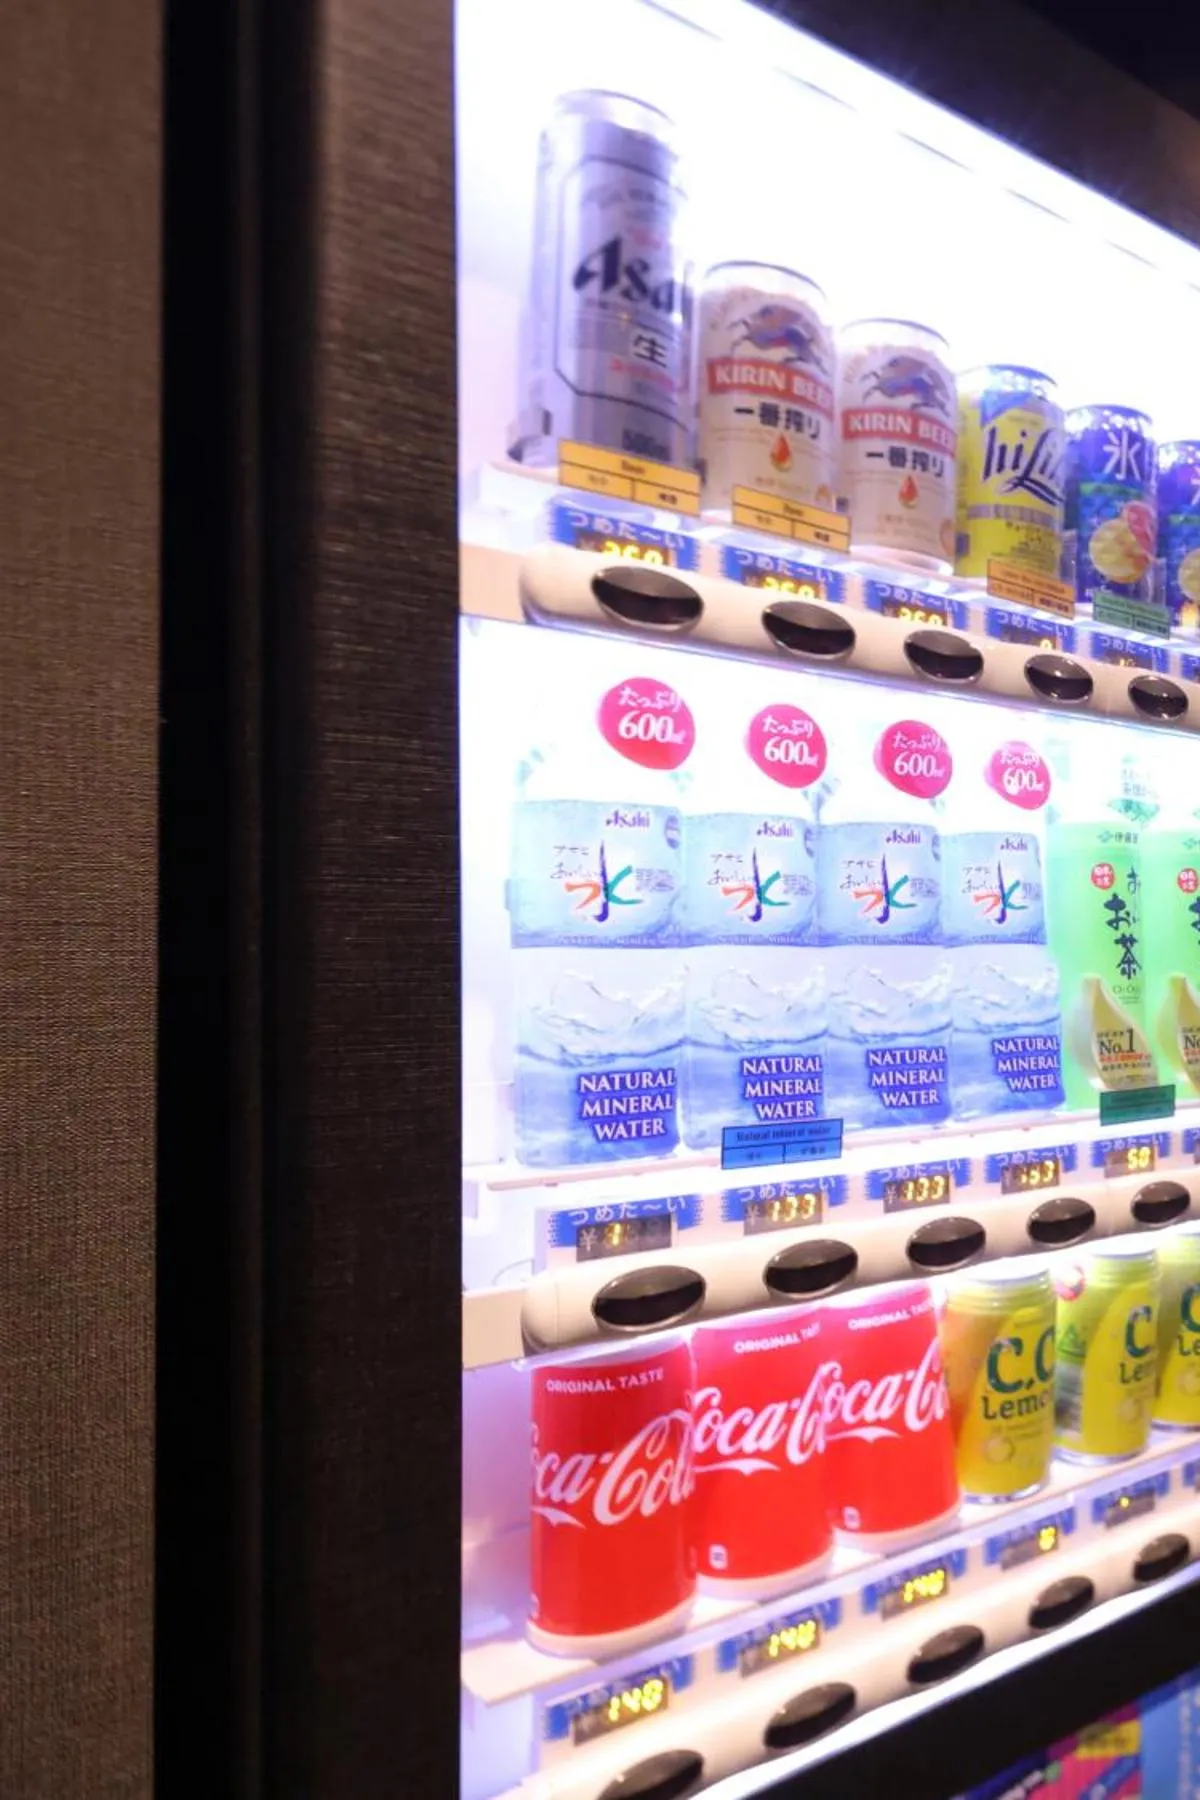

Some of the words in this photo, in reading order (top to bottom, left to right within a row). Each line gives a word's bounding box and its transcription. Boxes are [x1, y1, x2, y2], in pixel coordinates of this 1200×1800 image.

[633, 334, 667, 368] 生
[715, 364, 787, 390] KIRIN
[734, 402, 821, 439] 一番搾り
[849, 413, 912, 434] KIRIN
[866, 446, 944, 477] 一番搾り
[605, 809, 650, 828] Asahi
[756, 821, 794, 838] Asahi
[994, 1037, 1058, 1054] NATURAL
[1098, 1027, 1135, 1055] No.1
[743, 1057, 822, 1075] NATURAL
[869, 1049, 946, 1066] NATURAL
[998, 1056, 1059, 1072] MINERAL
[579, 1070, 676, 1093] NATURAL
[745, 1078, 822, 1098] MINERAL
[872, 1069, 945, 1087] MINERAL
[1008, 1075, 1056, 1090] WATER
[582, 1094, 673, 1117] MINERAL
[882, 1090, 940, 1107] WATER
[756, 1101, 816, 1119] WATER
[595, 1118, 665, 1141] WATER
[848, 1310, 911, 1331] ORIGINAL
[734, 1334, 800, 1354] ORIGINAL
[546, 1378, 615, 1393] ORIGINAL
[621, 1368, 664, 1389] TASTE
